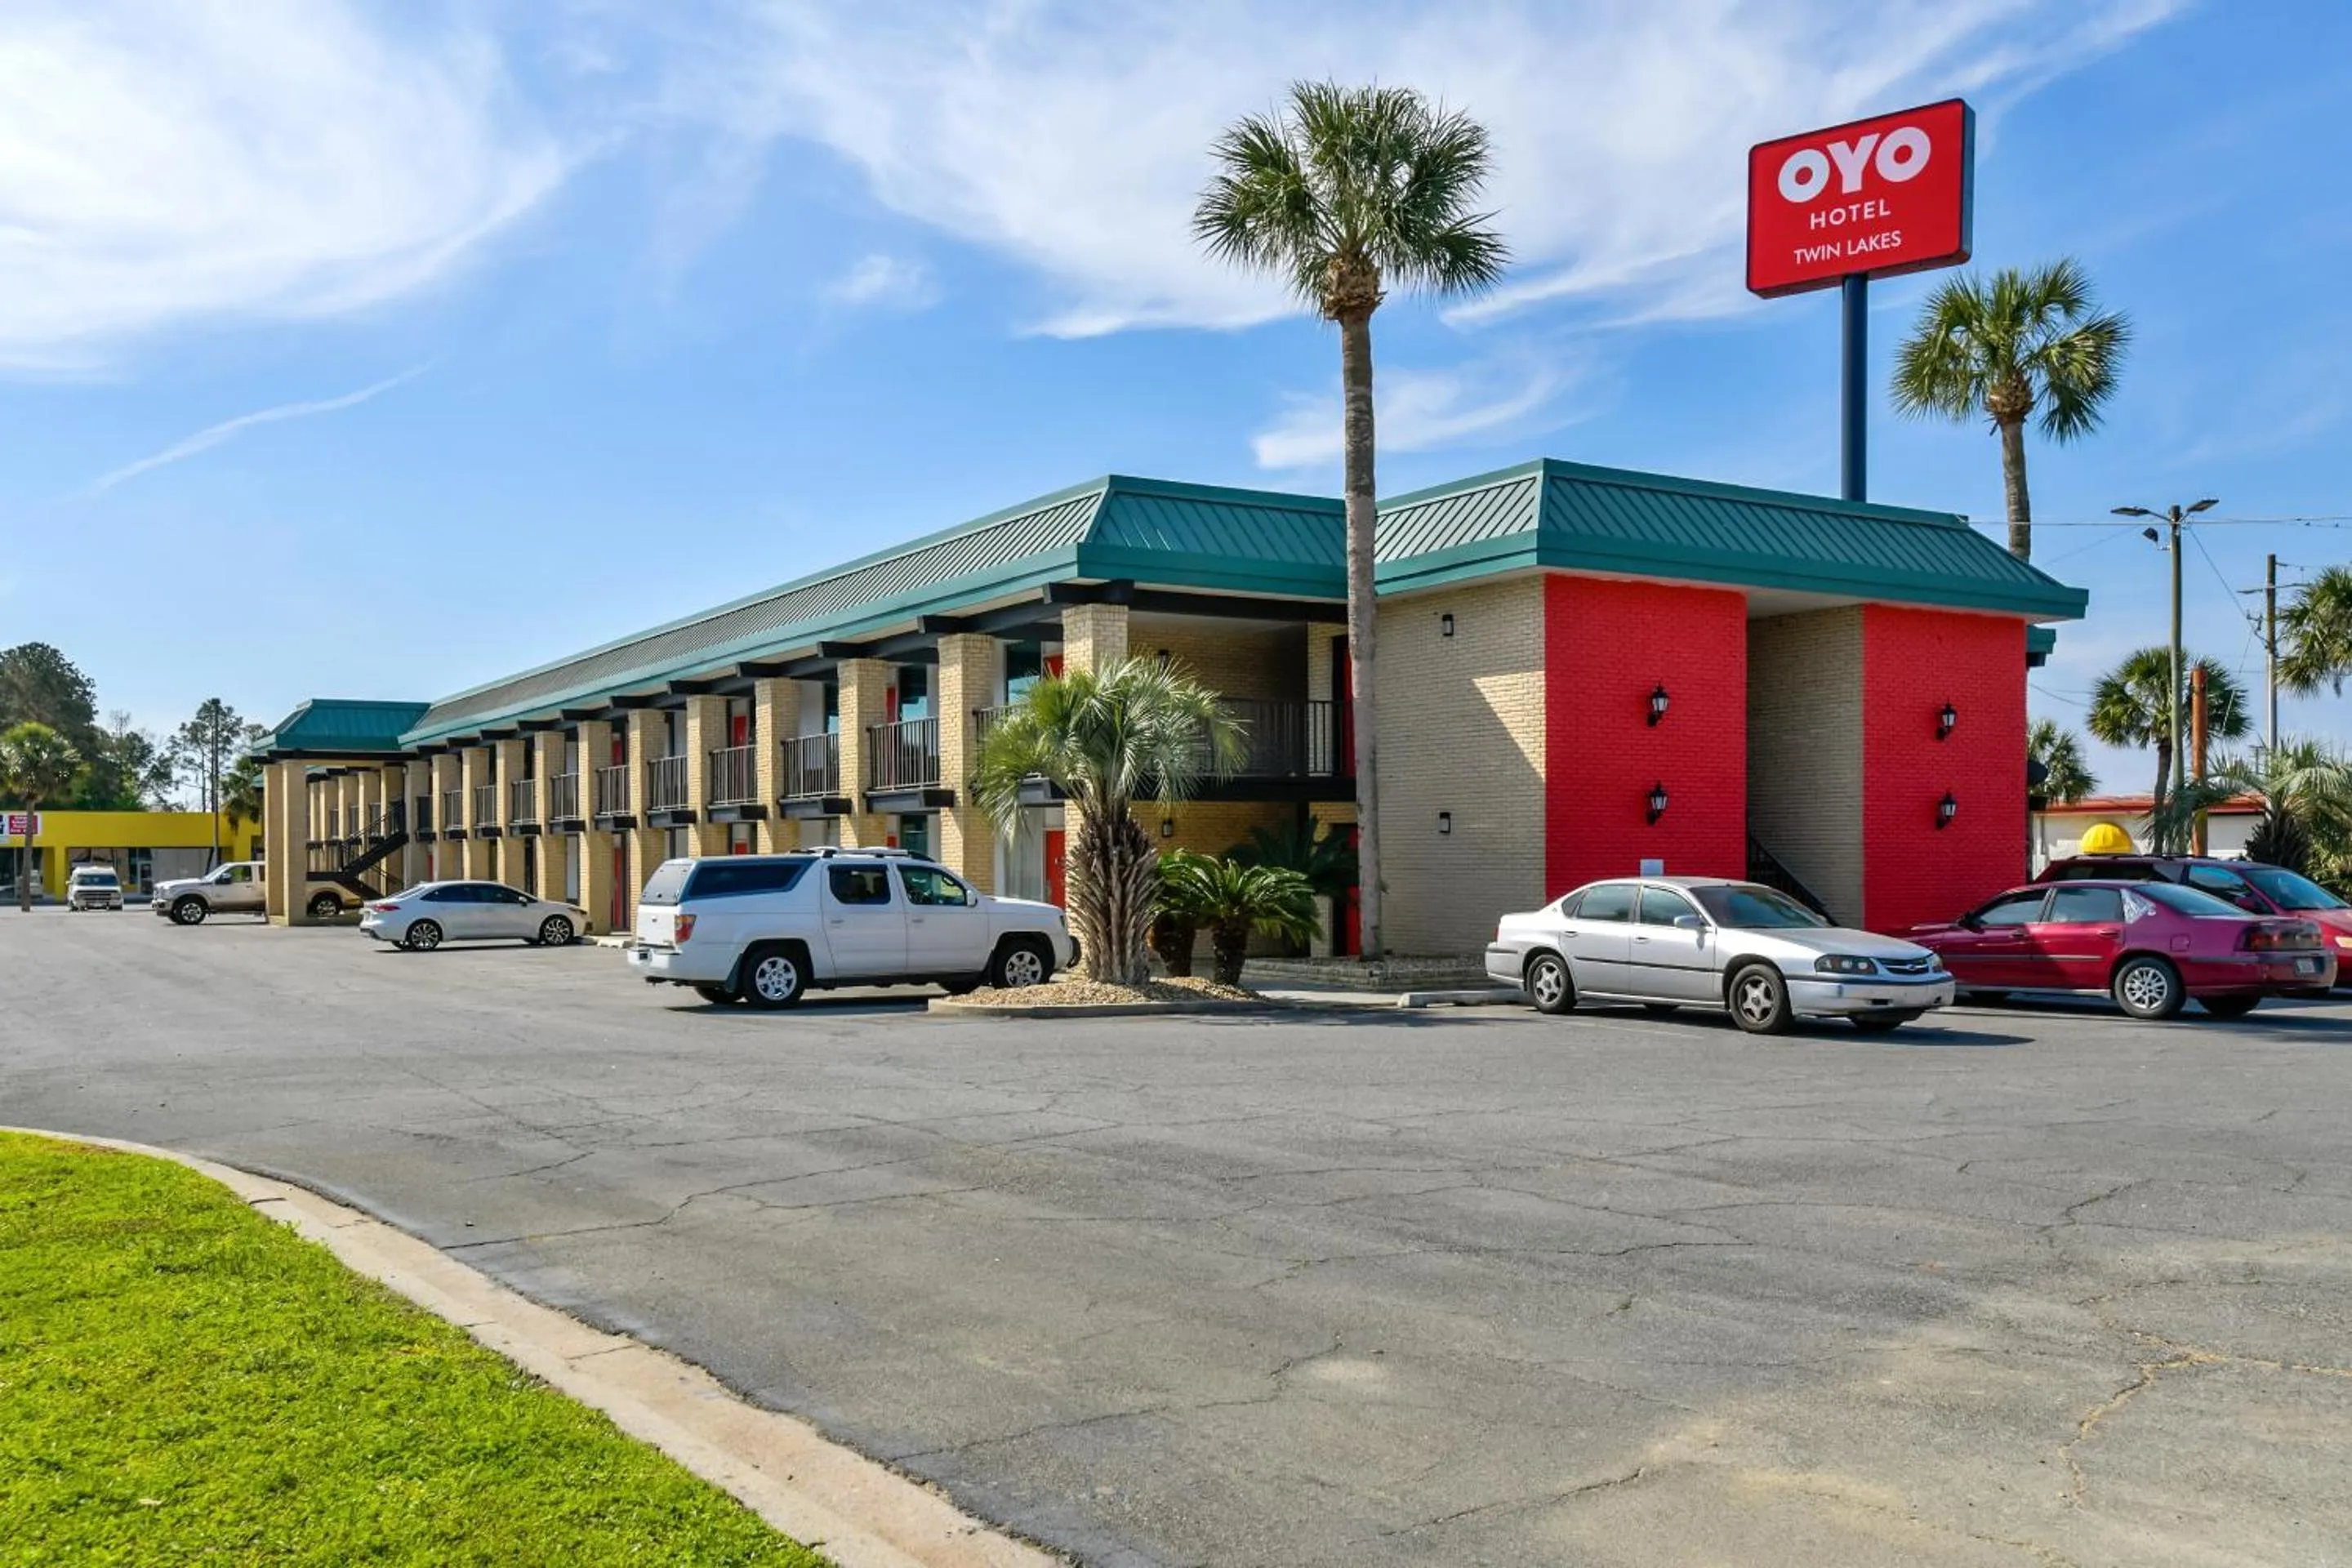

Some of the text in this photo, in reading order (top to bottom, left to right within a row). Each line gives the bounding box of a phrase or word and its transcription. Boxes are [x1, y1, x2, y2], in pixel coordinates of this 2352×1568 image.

[1777, 126, 1931, 203] OYO
[1810, 198, 1891, 229] HOTEL
[1793, 230, 1902, 265] TWIN LAKES
